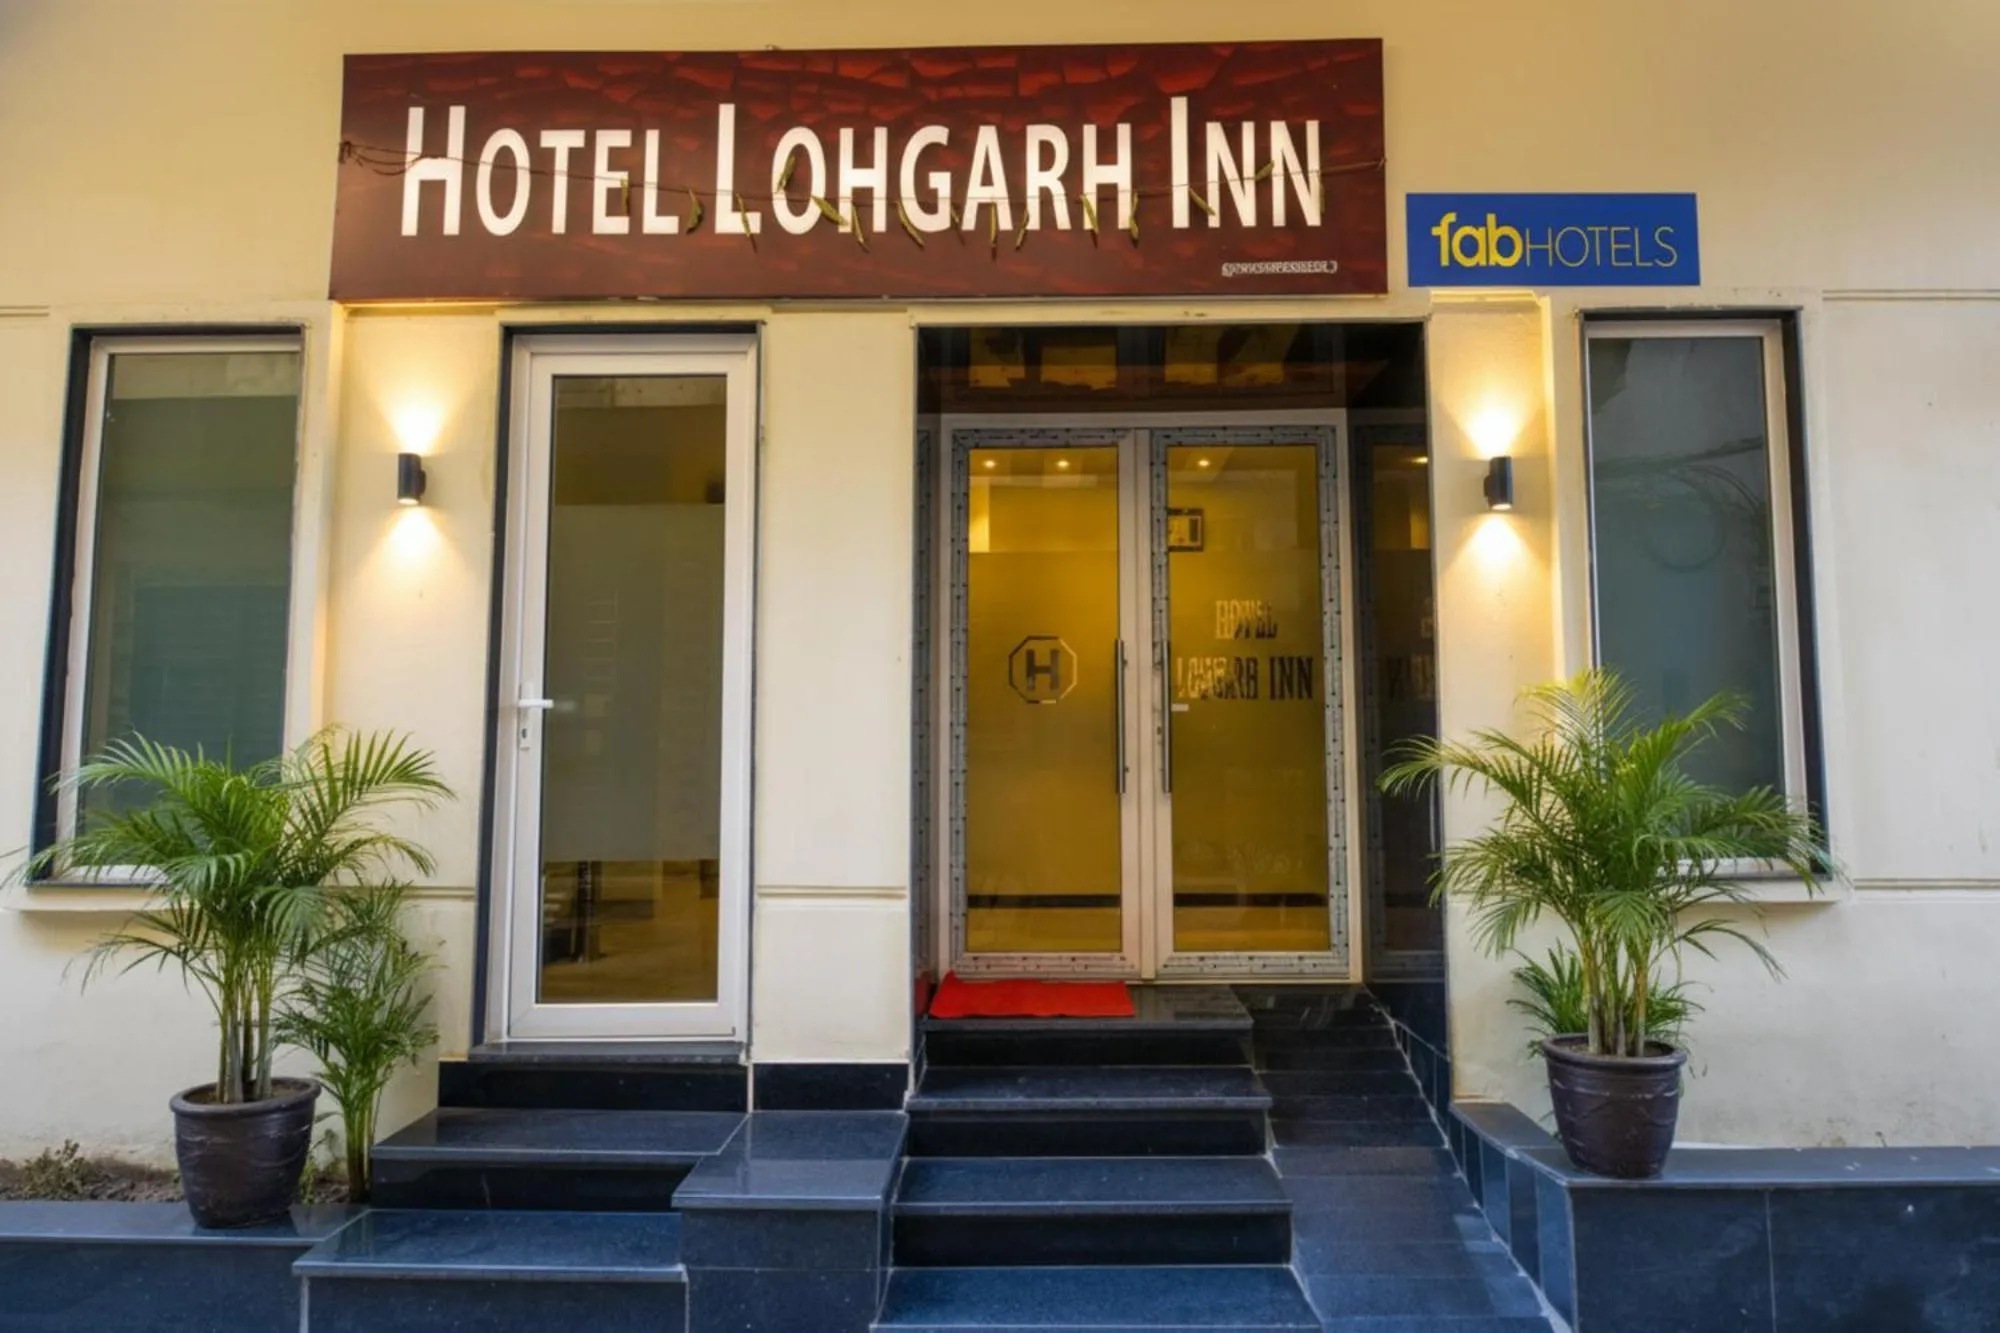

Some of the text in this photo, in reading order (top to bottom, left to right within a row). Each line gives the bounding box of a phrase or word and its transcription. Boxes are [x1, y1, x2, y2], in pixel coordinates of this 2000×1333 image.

[402, 97, 1321, 236] HOTEL LOHGARH INN
[1026, 648, 1060, 692] H
[1268, 656, 1314, 700] INN
